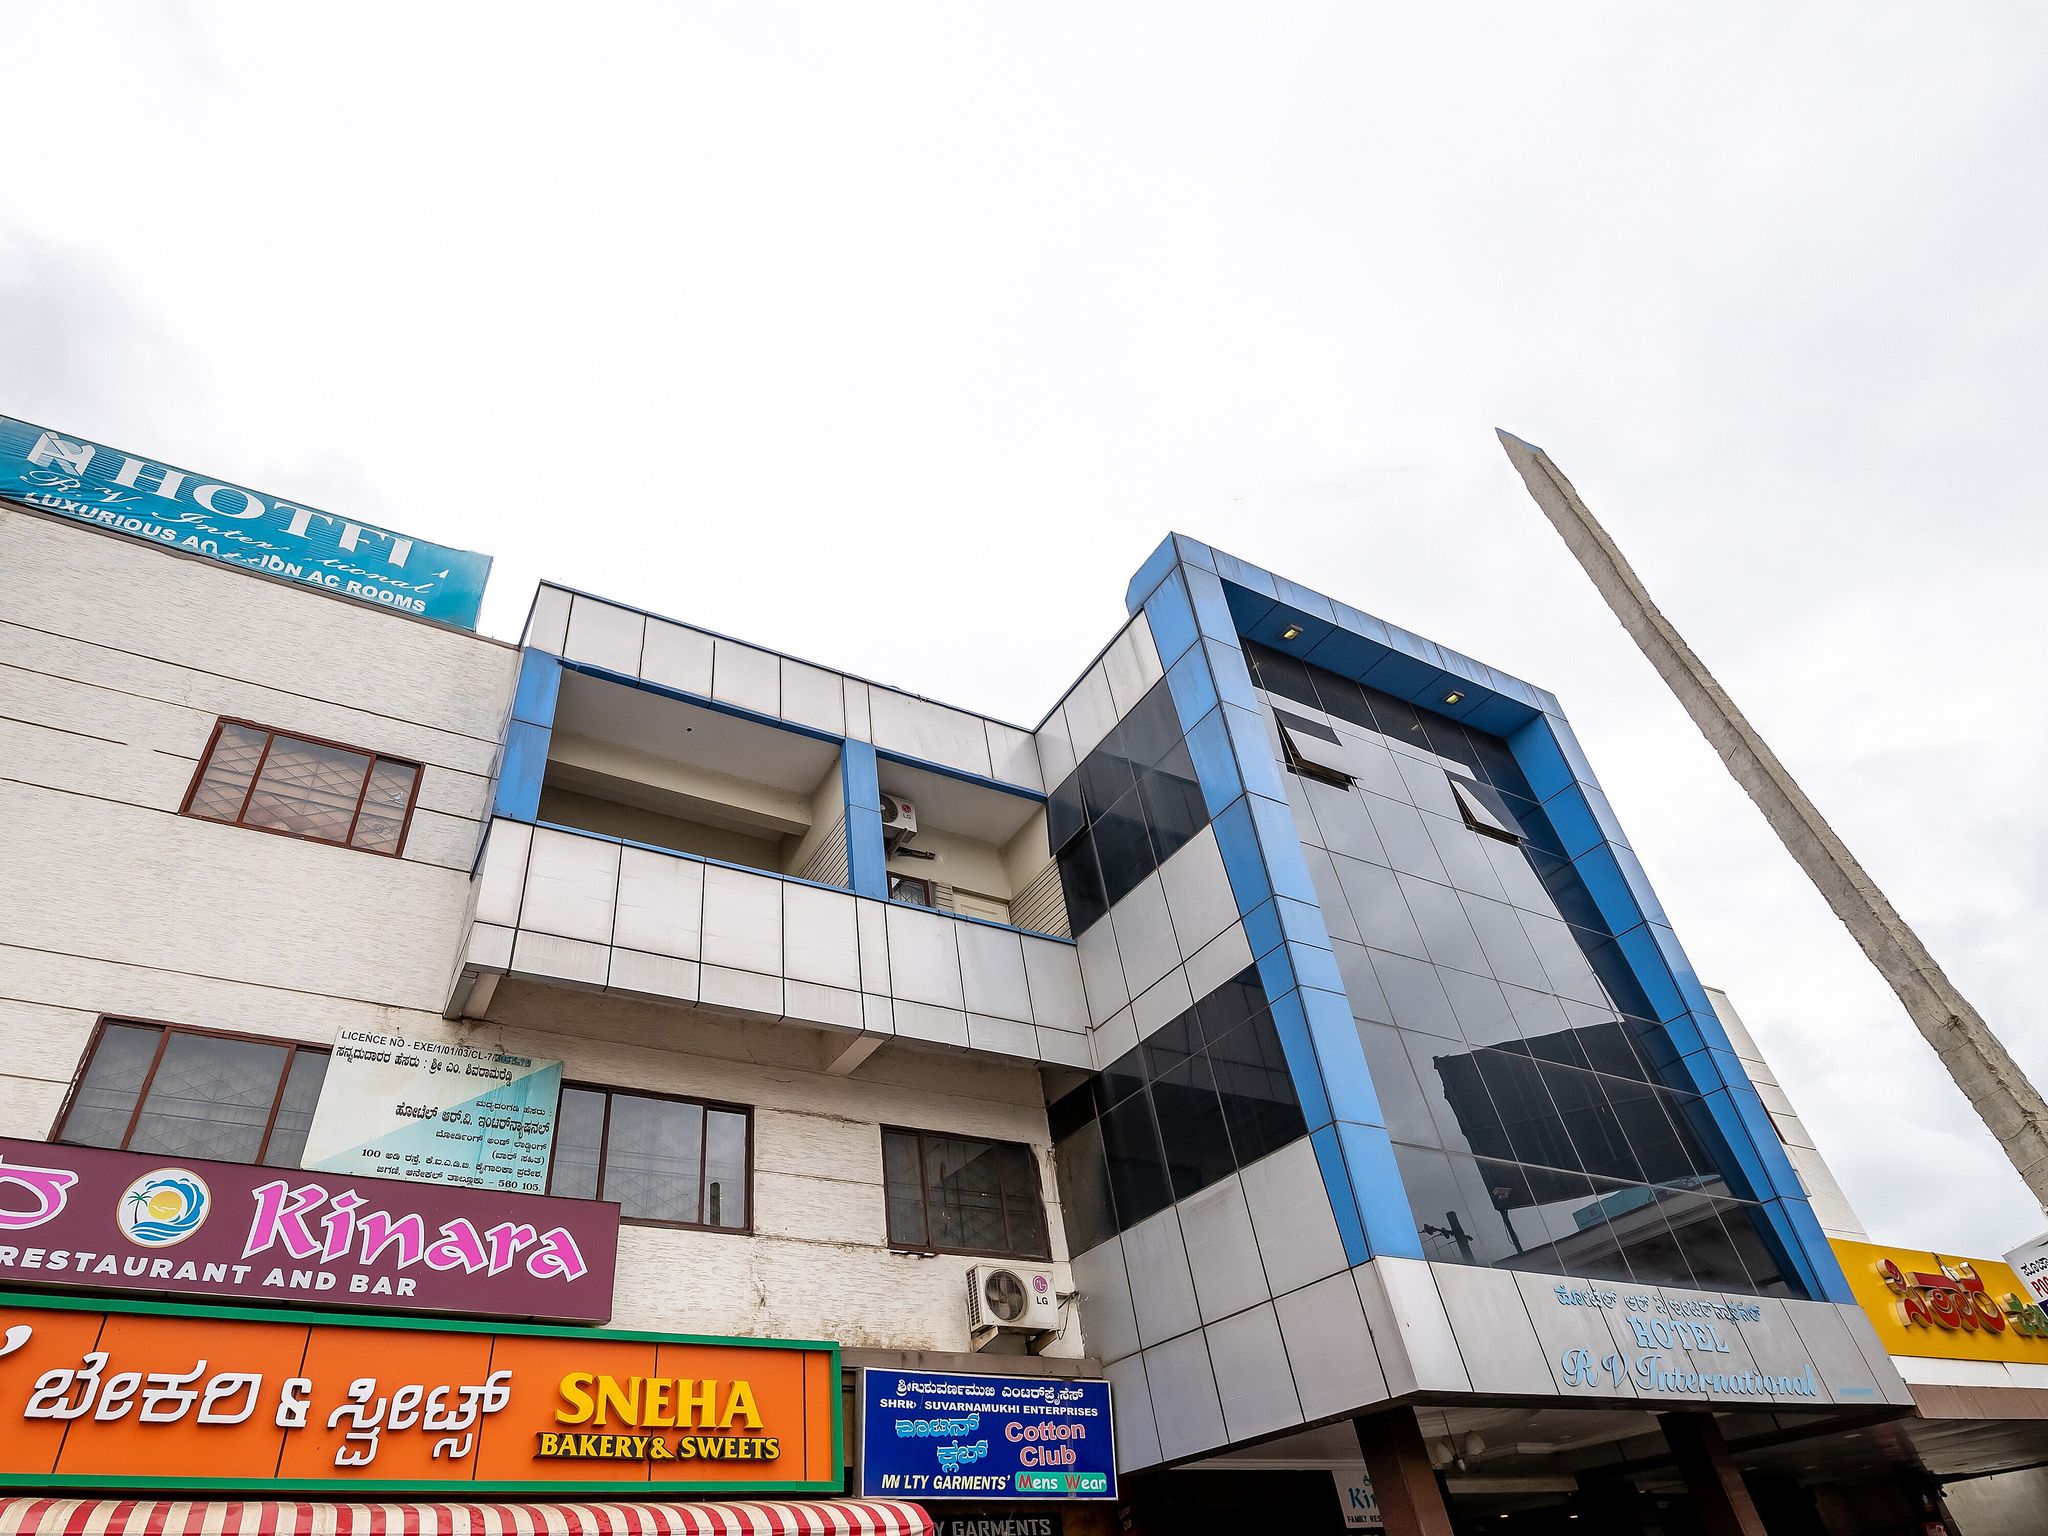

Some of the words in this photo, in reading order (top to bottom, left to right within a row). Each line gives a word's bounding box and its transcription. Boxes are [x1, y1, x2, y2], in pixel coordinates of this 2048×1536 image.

[25, 491, 177, 542] LUXURIOUS
[346, 580, 427, 612] ROOMS
[341, 1030, 388, 1046] LICENCE
[389, 1037, 405, 1048] NO
[361, 1148, 381, 1158] 100
[522, 1182, 541, 1193] 105.
[241, 1179, 588, 1283] Kinara
[0, 1245, 251, 1286] RESTAURANT
[262, 1267, 337, 1292] AND
[348, 1274, 417, 1298] BAR
[1036, 1296, 1049, 1306] LG
[1626, 1315, 1730, 1354] HOTEL
[1560, 1347, 1599, 1388] R
[1601, 1352, 1630, 1389] V
[1634, 1353, 1819, 1397] International
[23, 1352, 263, 1426] ಬೇಕರಿ
[274, 1376, 311, 1429] &
[554, 1371, 765, 1429] SNEHA
[924, 1400, 1020, 1414] SUVARNAMUKHI
[1023, 1405, 1099, 1417] ENTERPRISES
[1004, 1420, 1086, 1443] Cotton
[680, 1435, 781, 1461] SWEETS
[1019, 1444, 1077, 1467] Club
[1017, 1472, 1058, 1490] Mens
[1064, 1473, 1107, 1491] Wear
[952, 1518, 1051, 1536] GARMENTS
